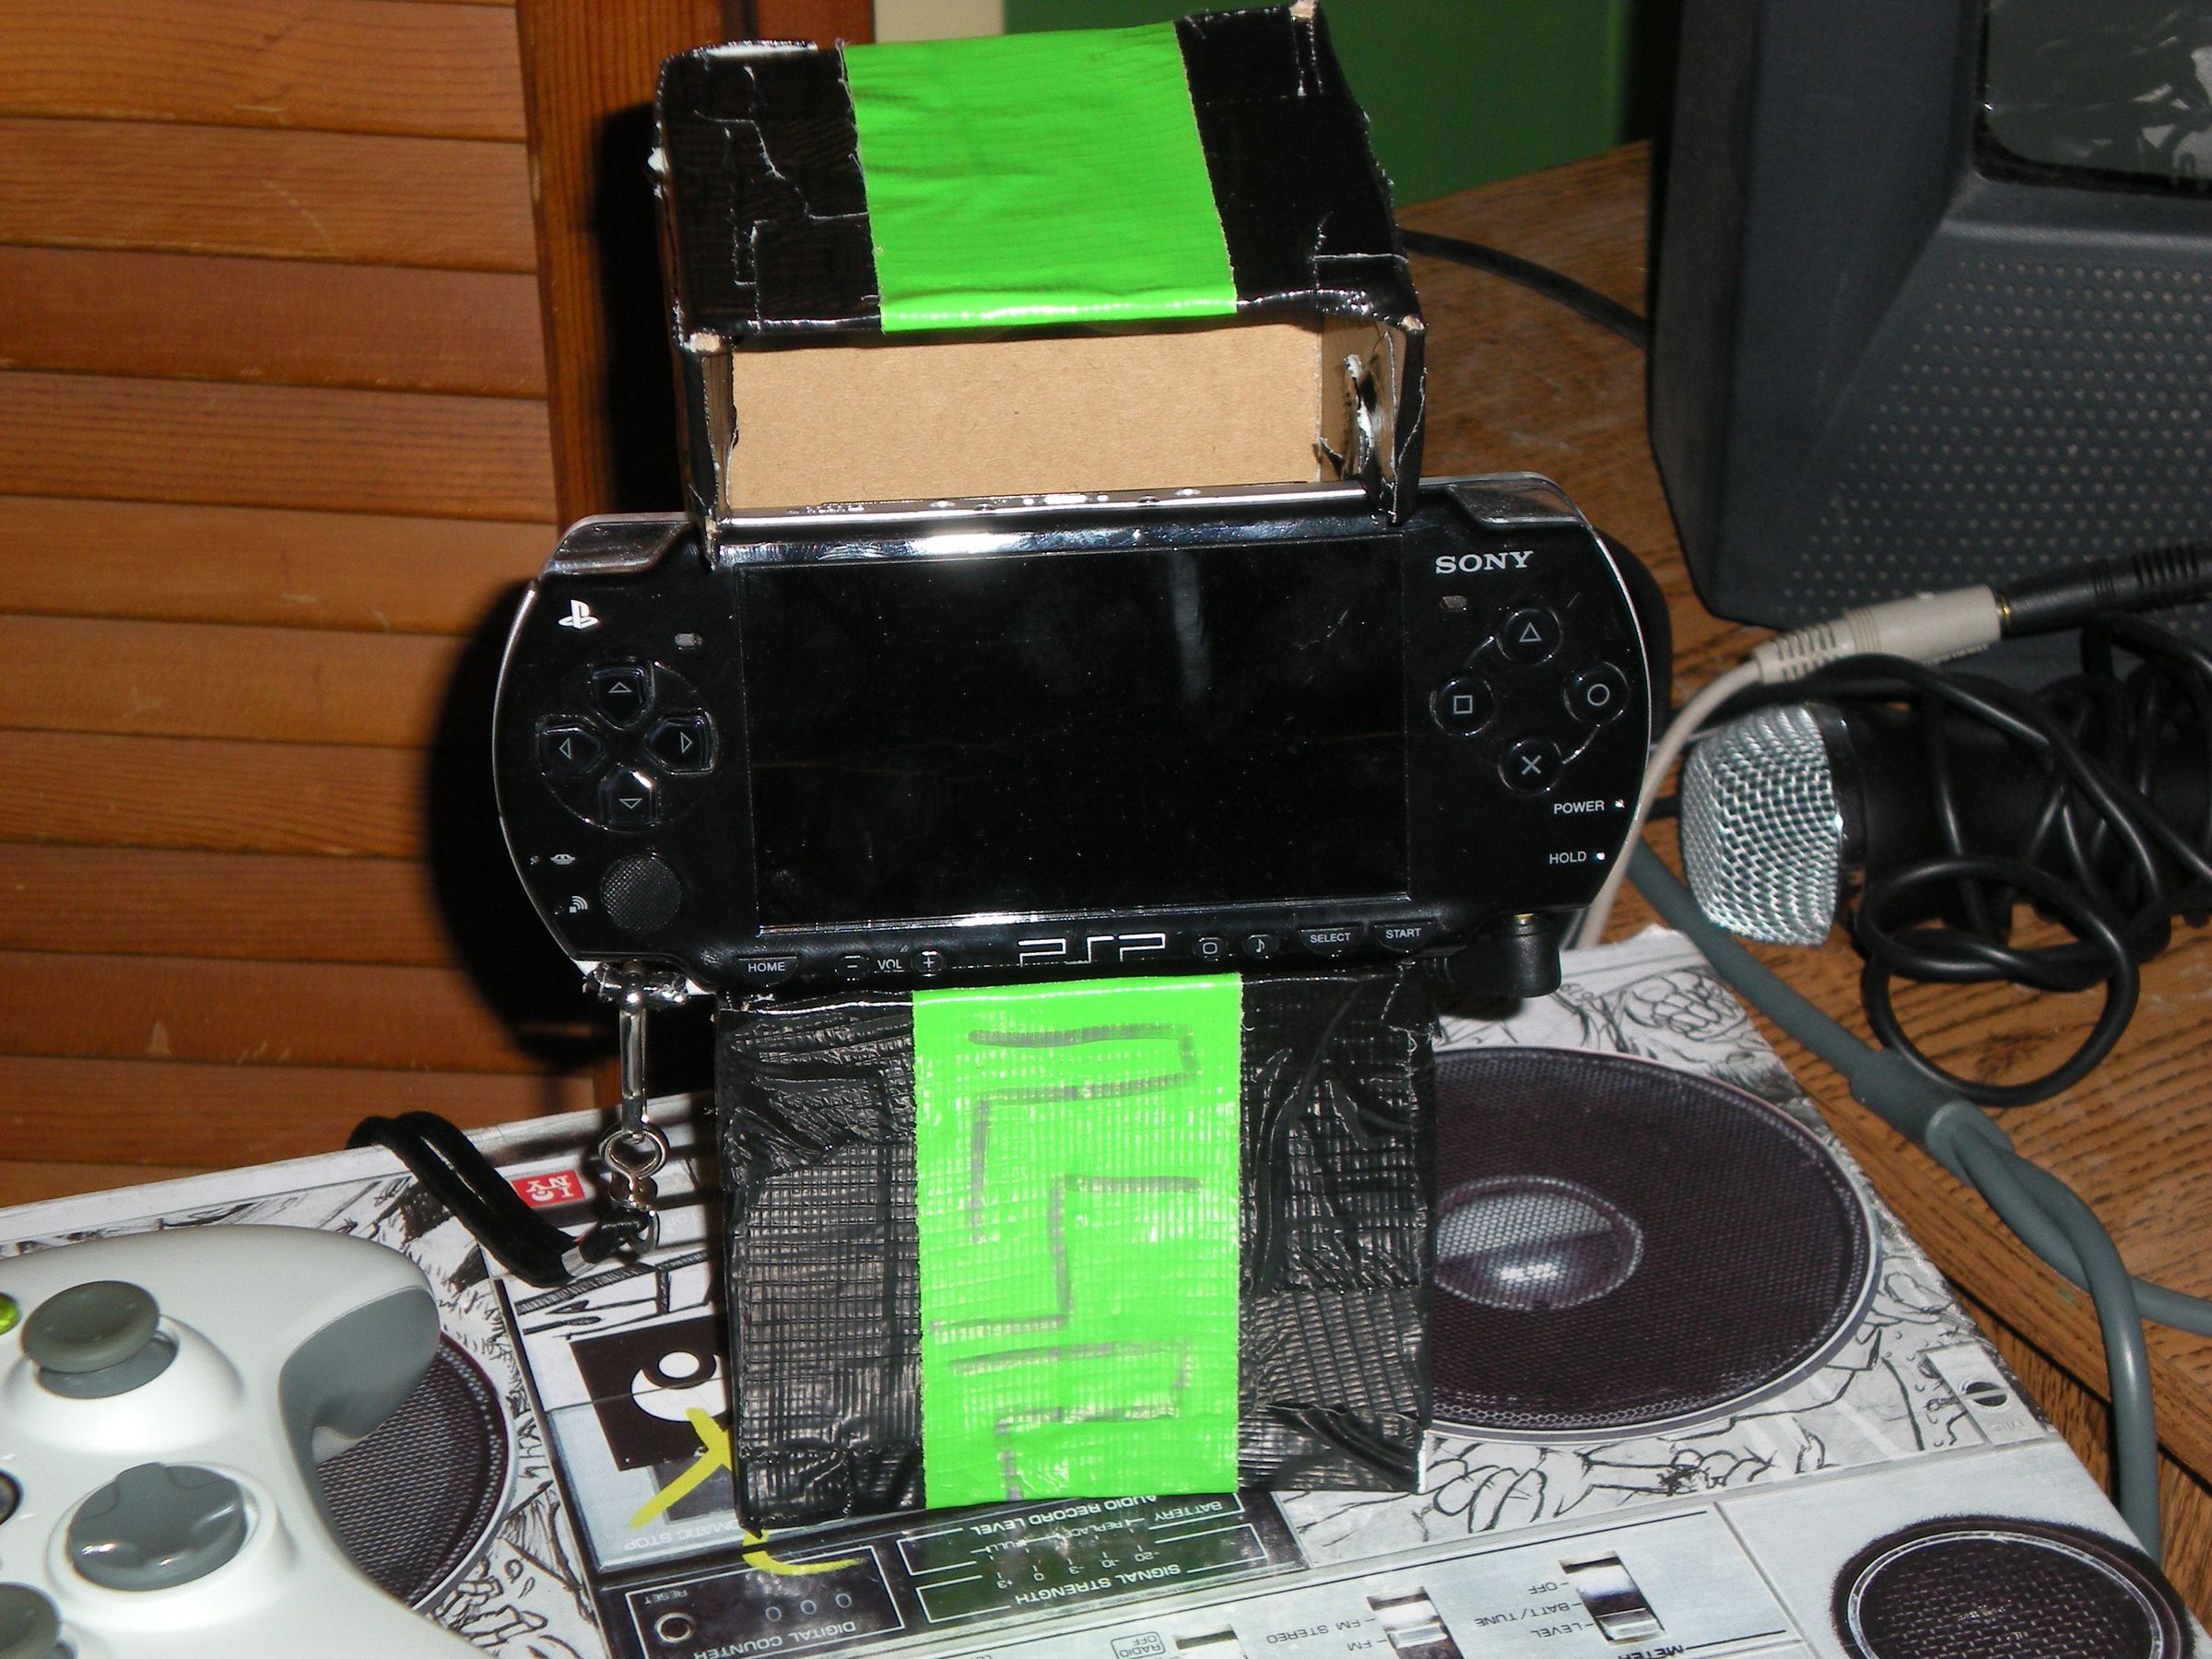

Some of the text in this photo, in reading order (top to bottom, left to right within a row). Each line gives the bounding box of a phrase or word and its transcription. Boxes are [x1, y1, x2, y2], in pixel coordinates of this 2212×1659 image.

[1435, 550, 1534, 574] SONY
[1553, 800, 1605, 815] POWER
[1548, 851, 1587, 865] HOLD
[1309, 930, 1351, 944] SELECT
[1384, 925, 1421, 939] START
[1018, 933, 1166, 968] PSP
[747, 960, 786, 973] HOME
[877, 959, 904, 971] VOL
[970, 1495, 1158, 1535] AUDIO RECORD LEVEL
[1154, 1500, 1223, 1521] BATTERY
[1064, 1521, 1124, 1538] REPLACE
[624, 1533, 673, 1551] STOP
[1014, 1564, 1182, 1604] SIGNAL STRENGTH
[1527, 1581, 1559, 1594] OFF
[645, 1589, 688, 1605] RESET
[1475, 1601, 1571, 1628] BATT/TUNE
[1265, 1619, 1361, 1644] FM STEREO
[1530, 1622, 1583, 1639] LEVEL
[693, 1620, 856, 1659] DIGITAL COUNTER
[1133, 1634, 1157, 1646] OFF
[1347, 1640, 1372, 1652] FM
[1119, 1644, 1161, 1658] RADIO
